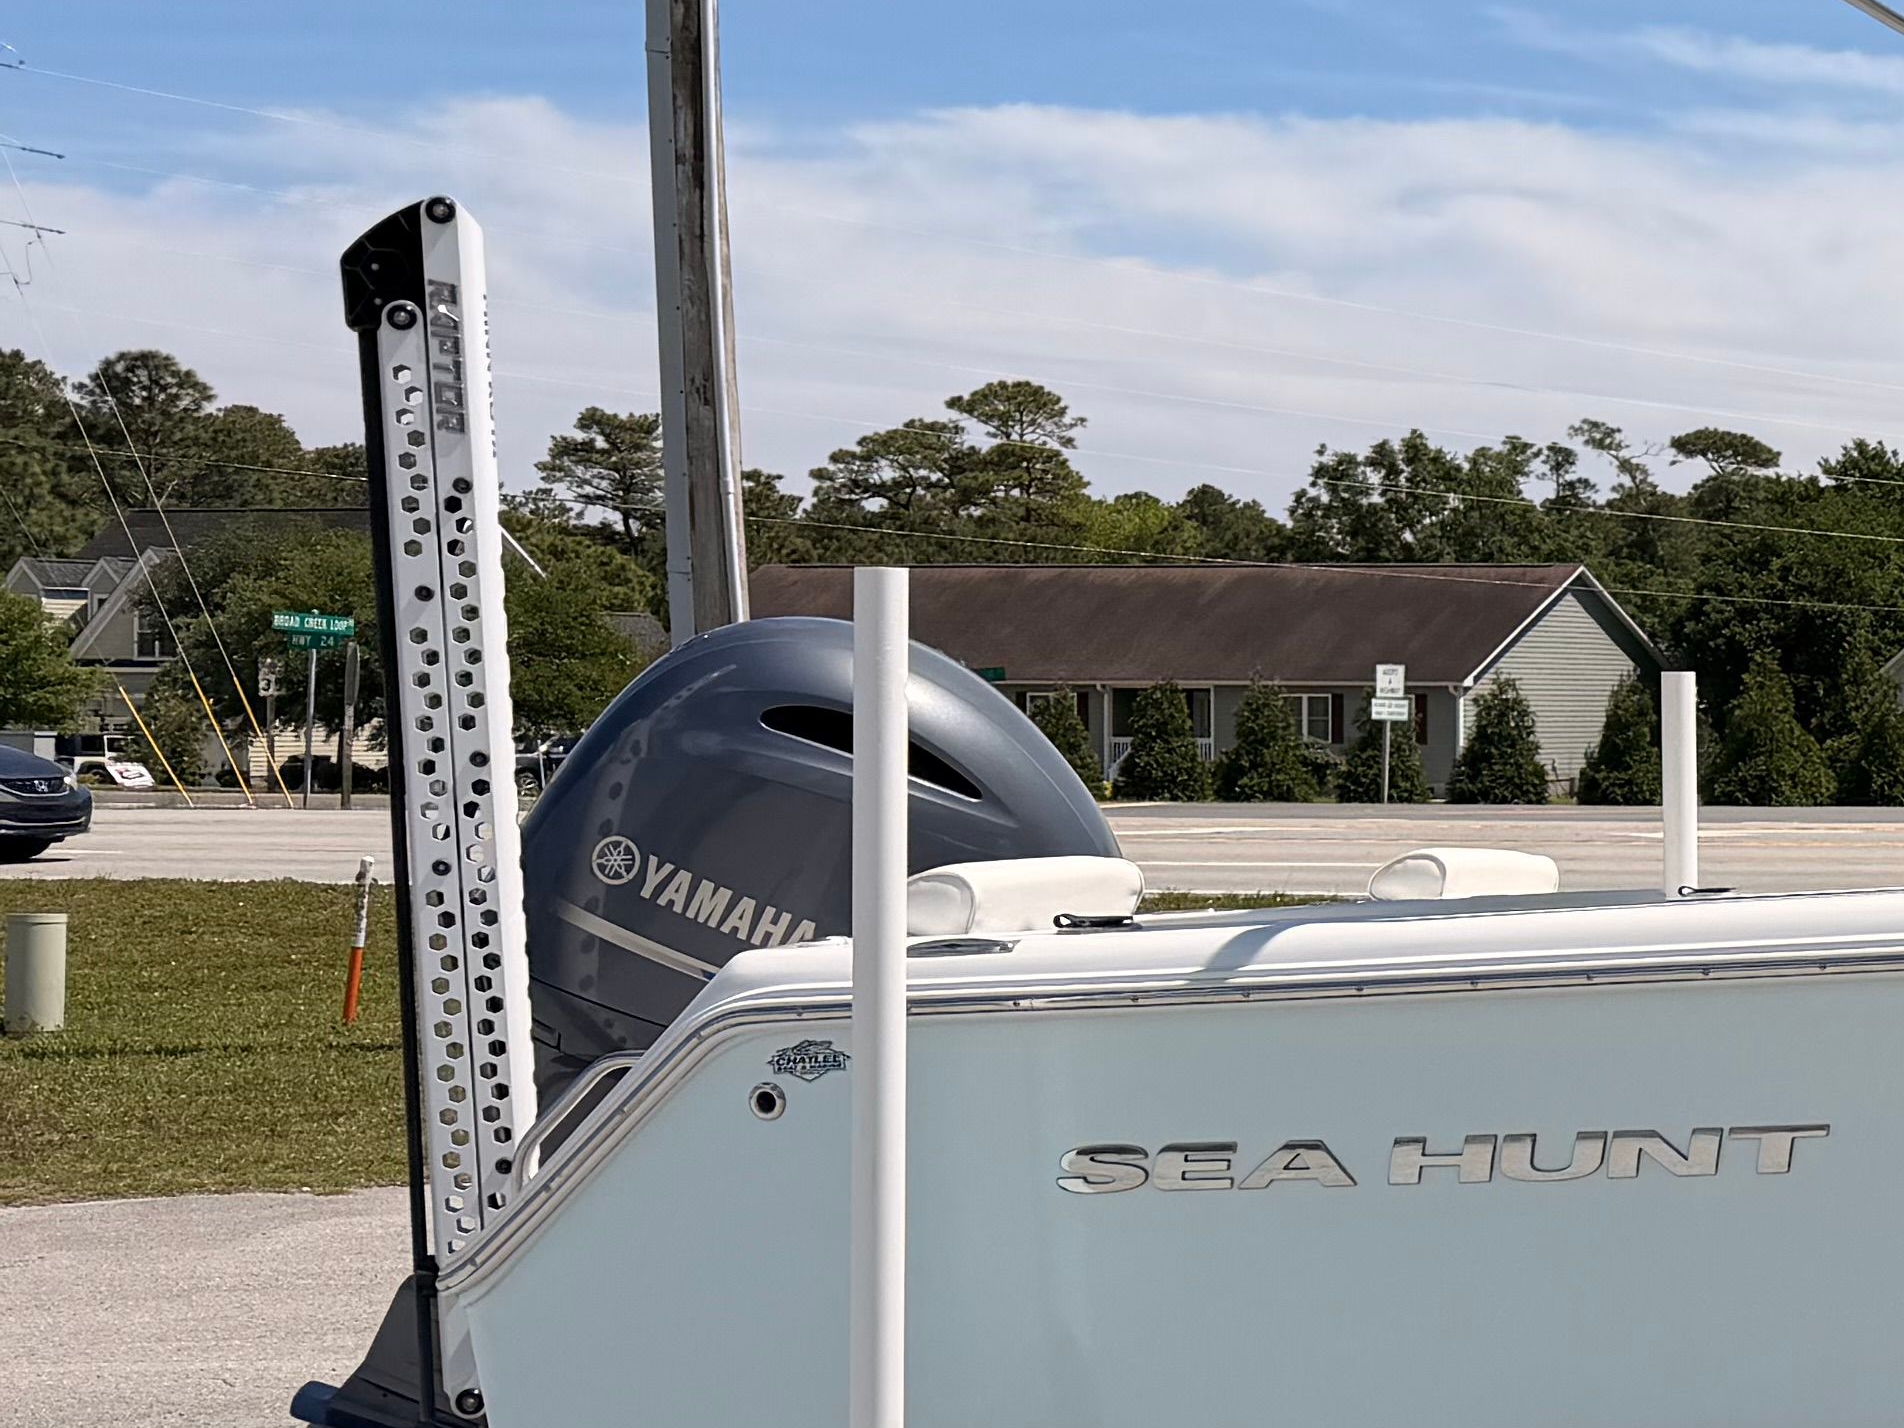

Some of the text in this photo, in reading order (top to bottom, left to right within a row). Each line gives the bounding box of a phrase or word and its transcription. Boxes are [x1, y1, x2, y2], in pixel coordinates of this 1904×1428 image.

[427, 278, 465, 435] RAPTOR
[292, 634, 334, 647] HWY 24
[1056, 1123, 1831, 1194] SEA HUNT
